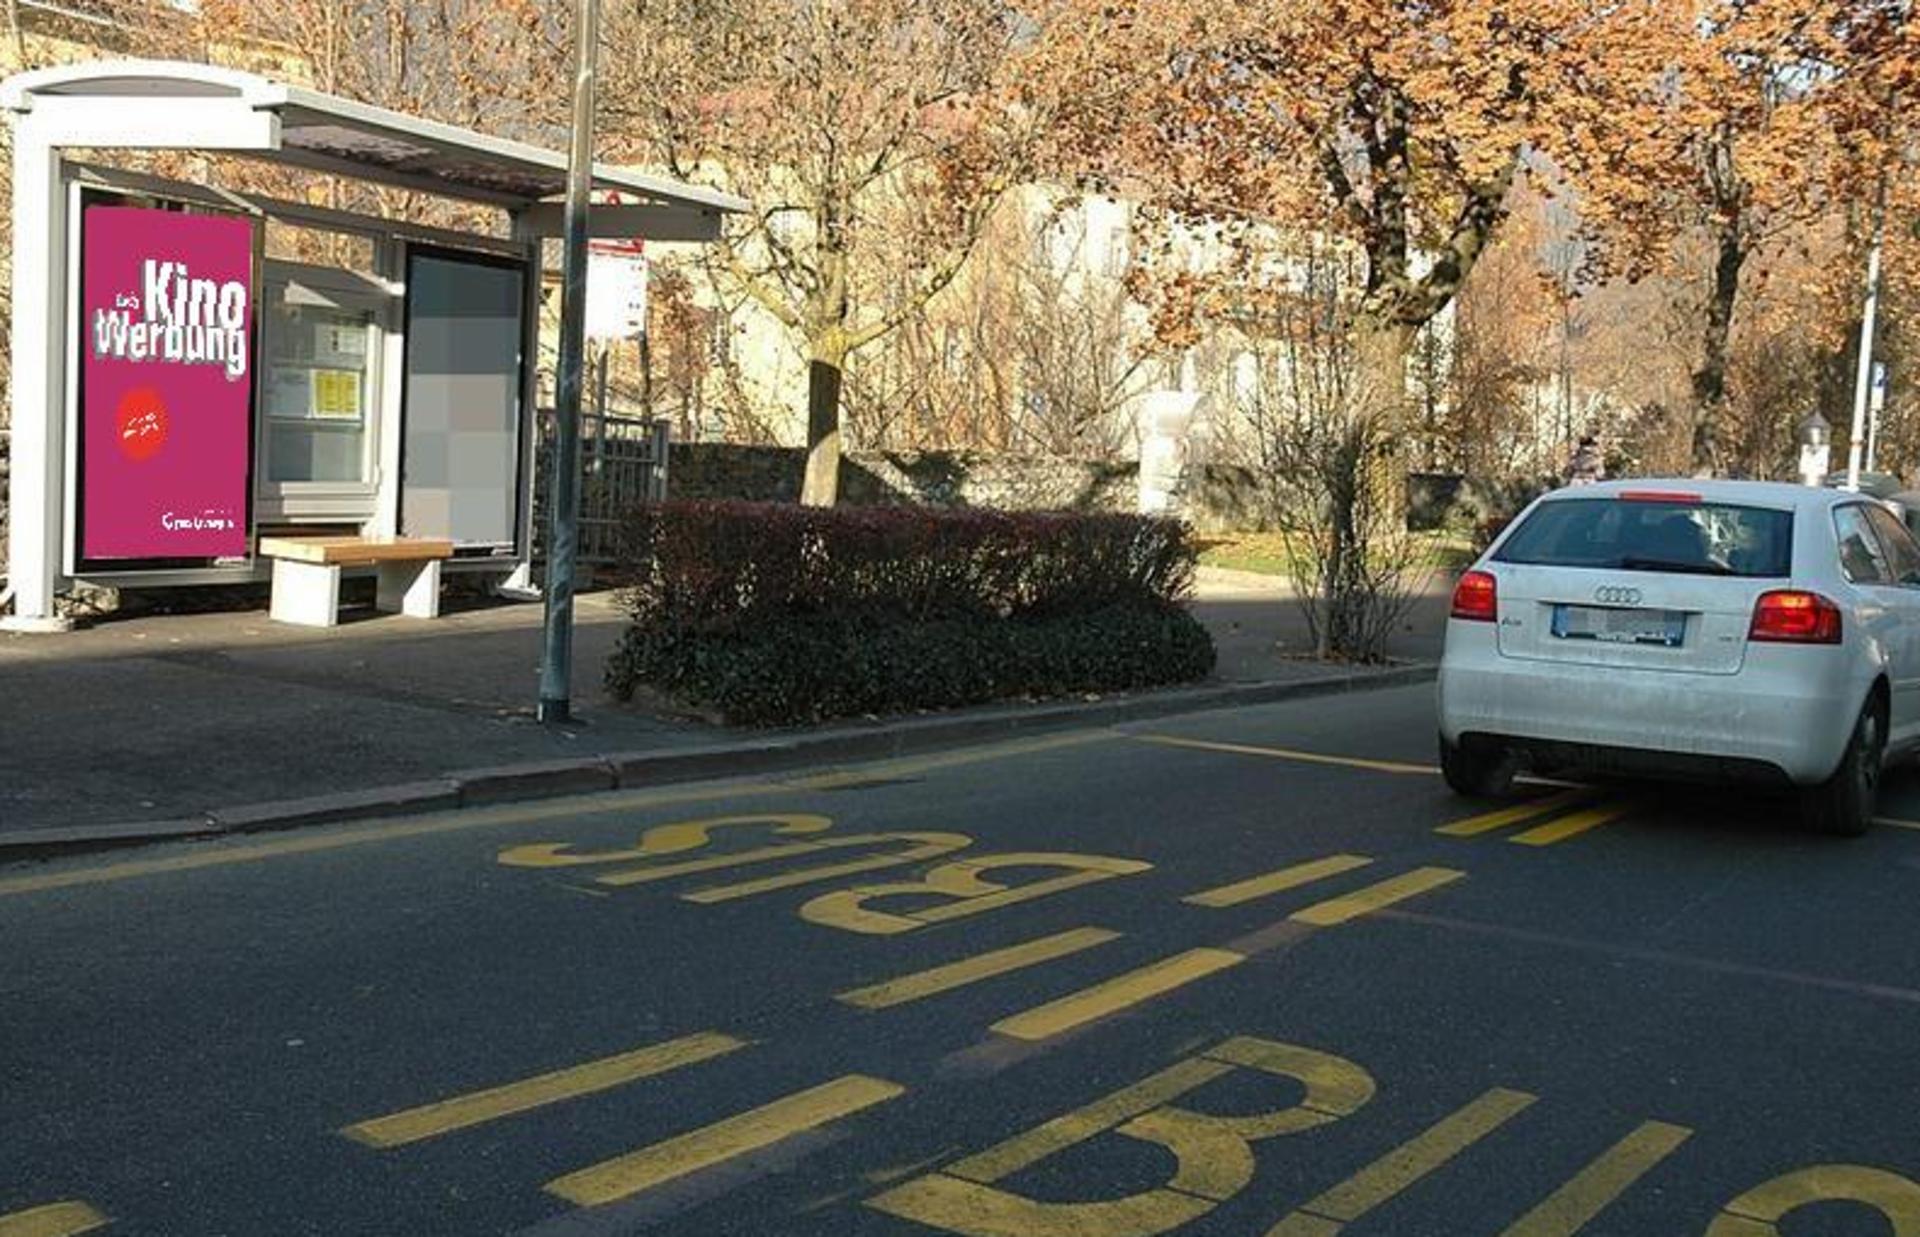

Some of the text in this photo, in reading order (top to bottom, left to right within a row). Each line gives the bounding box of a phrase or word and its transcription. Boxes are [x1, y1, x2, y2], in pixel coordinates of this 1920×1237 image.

[143, 259, 246, 329] Kino
[95, 308, 247, 378] Werbung
[497, 813, 1154, 934] BUS
